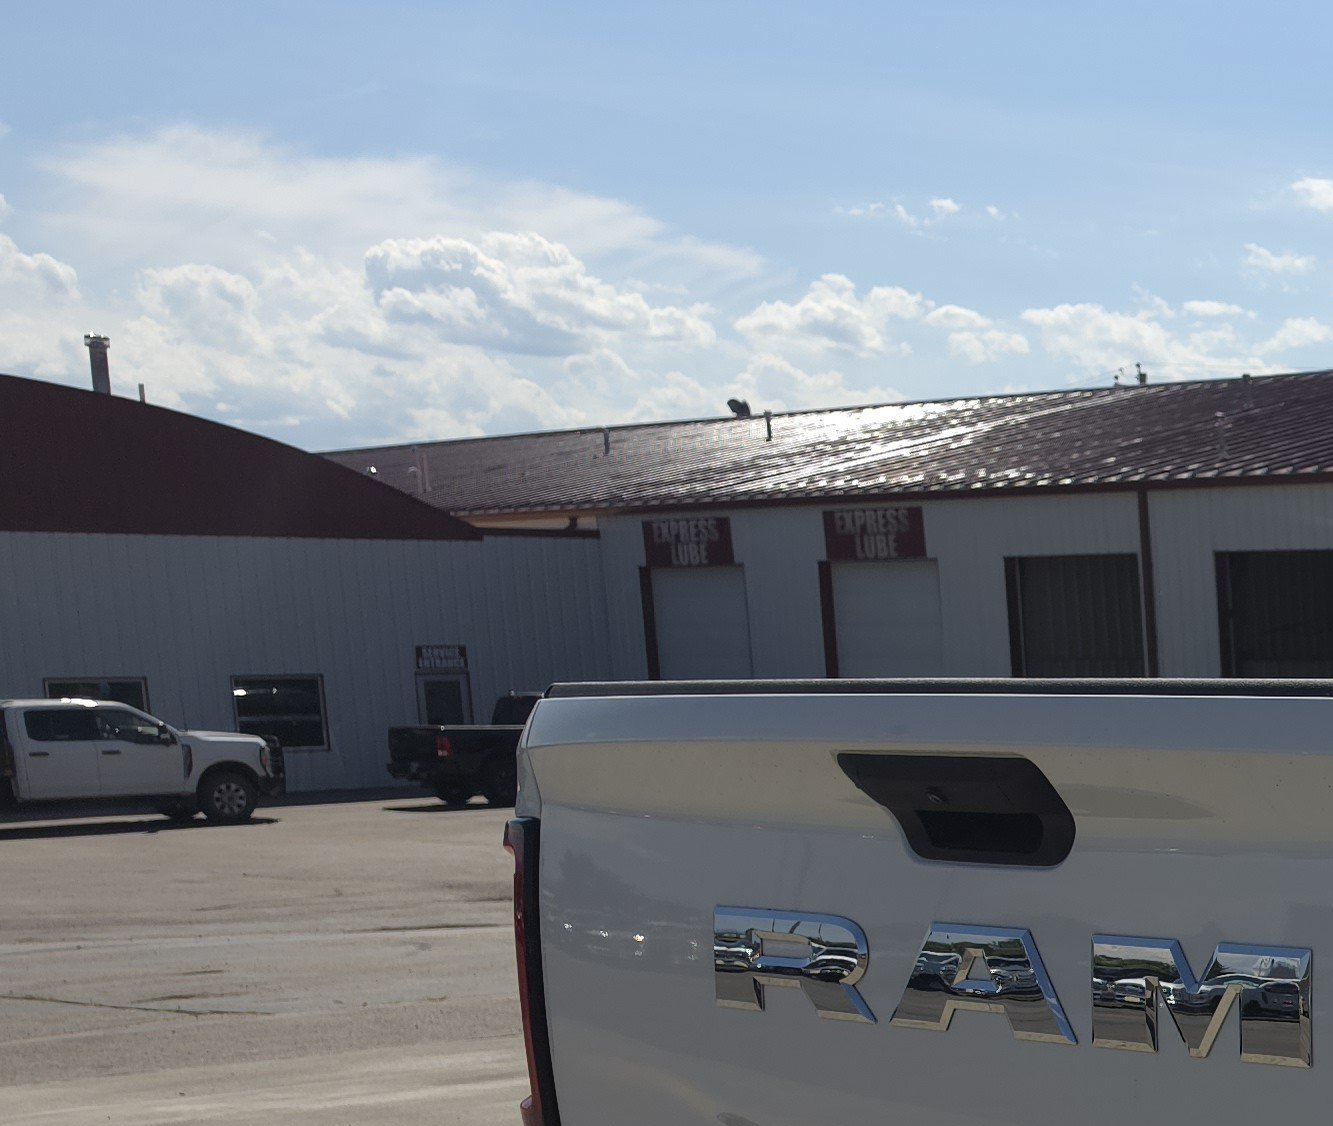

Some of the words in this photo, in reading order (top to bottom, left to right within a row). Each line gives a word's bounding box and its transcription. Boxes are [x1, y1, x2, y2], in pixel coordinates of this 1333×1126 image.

[652, 518, 720, 543] EXPRESS
[834, 508, 911, 535] EXPRESS
[670, 541, 709, 565] LUBE
[854, 534, 900, 559] LUBE
[713, 905, 1312, 1068] RAM
